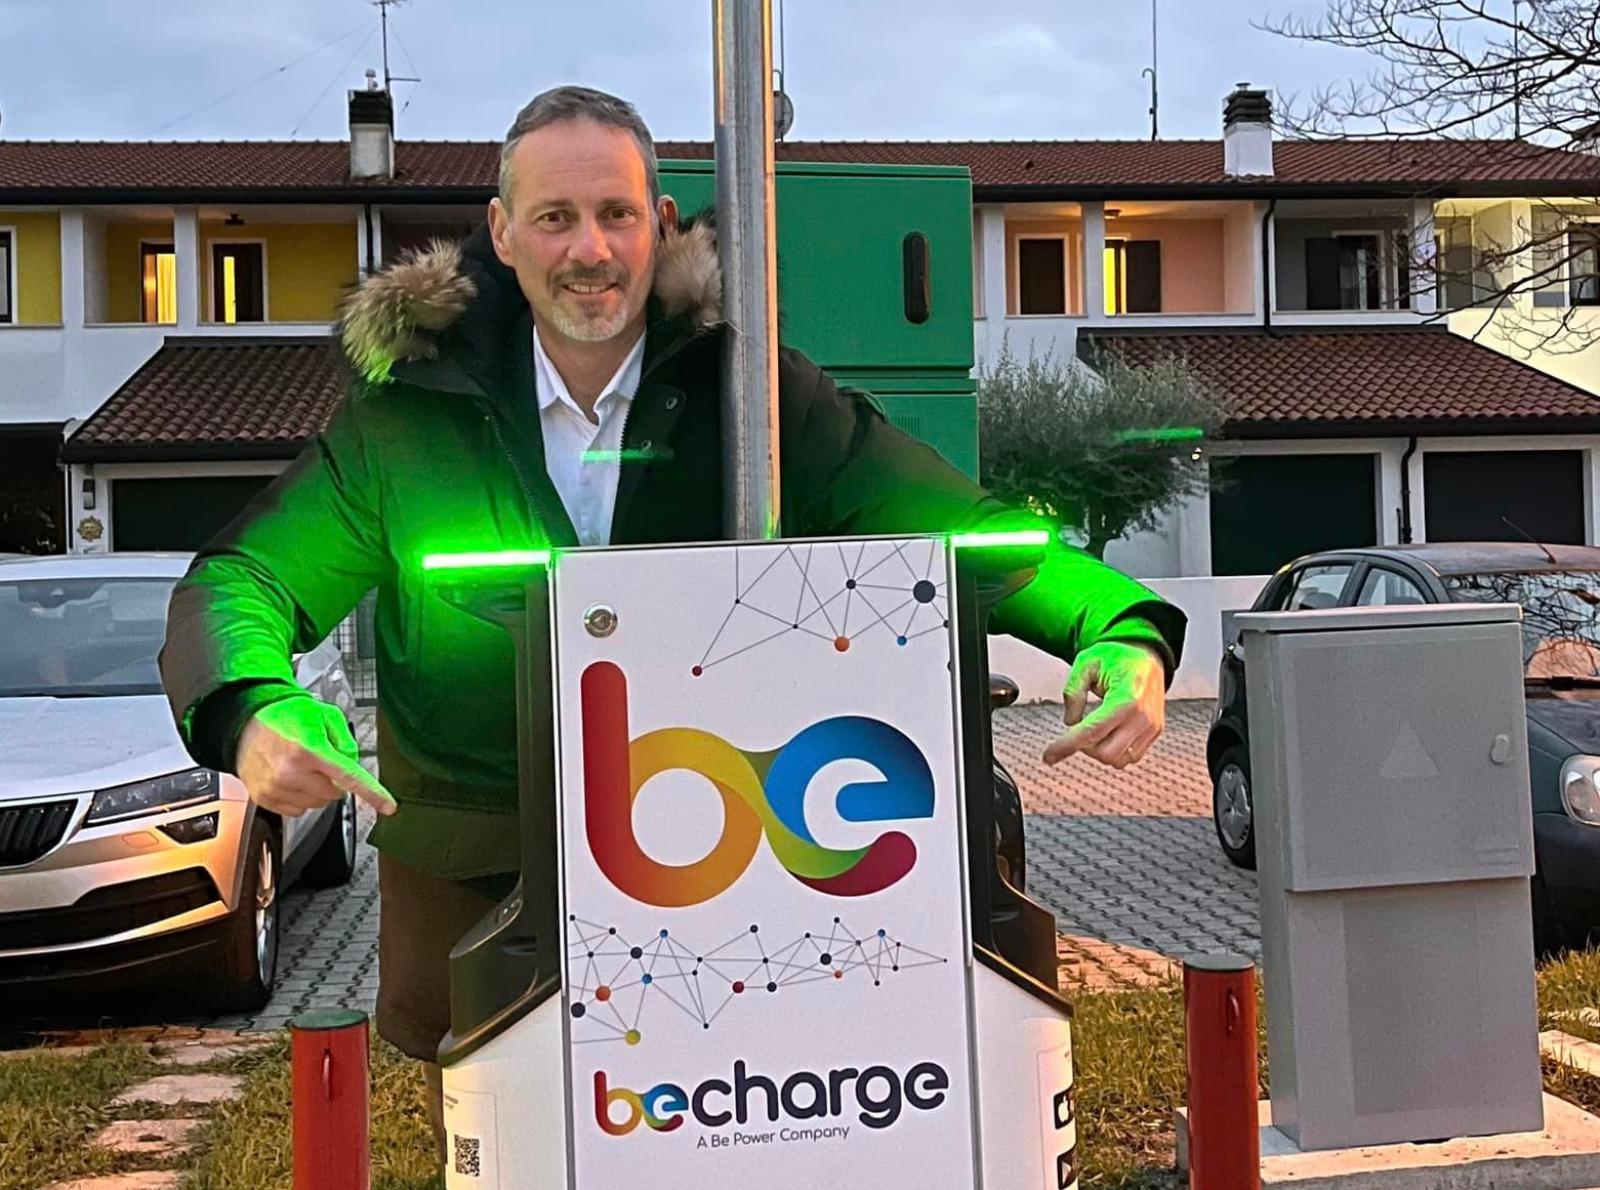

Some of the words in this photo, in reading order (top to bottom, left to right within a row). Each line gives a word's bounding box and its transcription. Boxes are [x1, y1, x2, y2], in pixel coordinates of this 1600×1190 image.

[580, 660, 936, 908] be
[594, 1060, 949, 1136] becharge
[697, 1135, 708, 1149] A
[711, 1134, 730, 1148] Be
[734, 1131, 775, 1146] Power
[780, 1125, 850, 1143] Company
